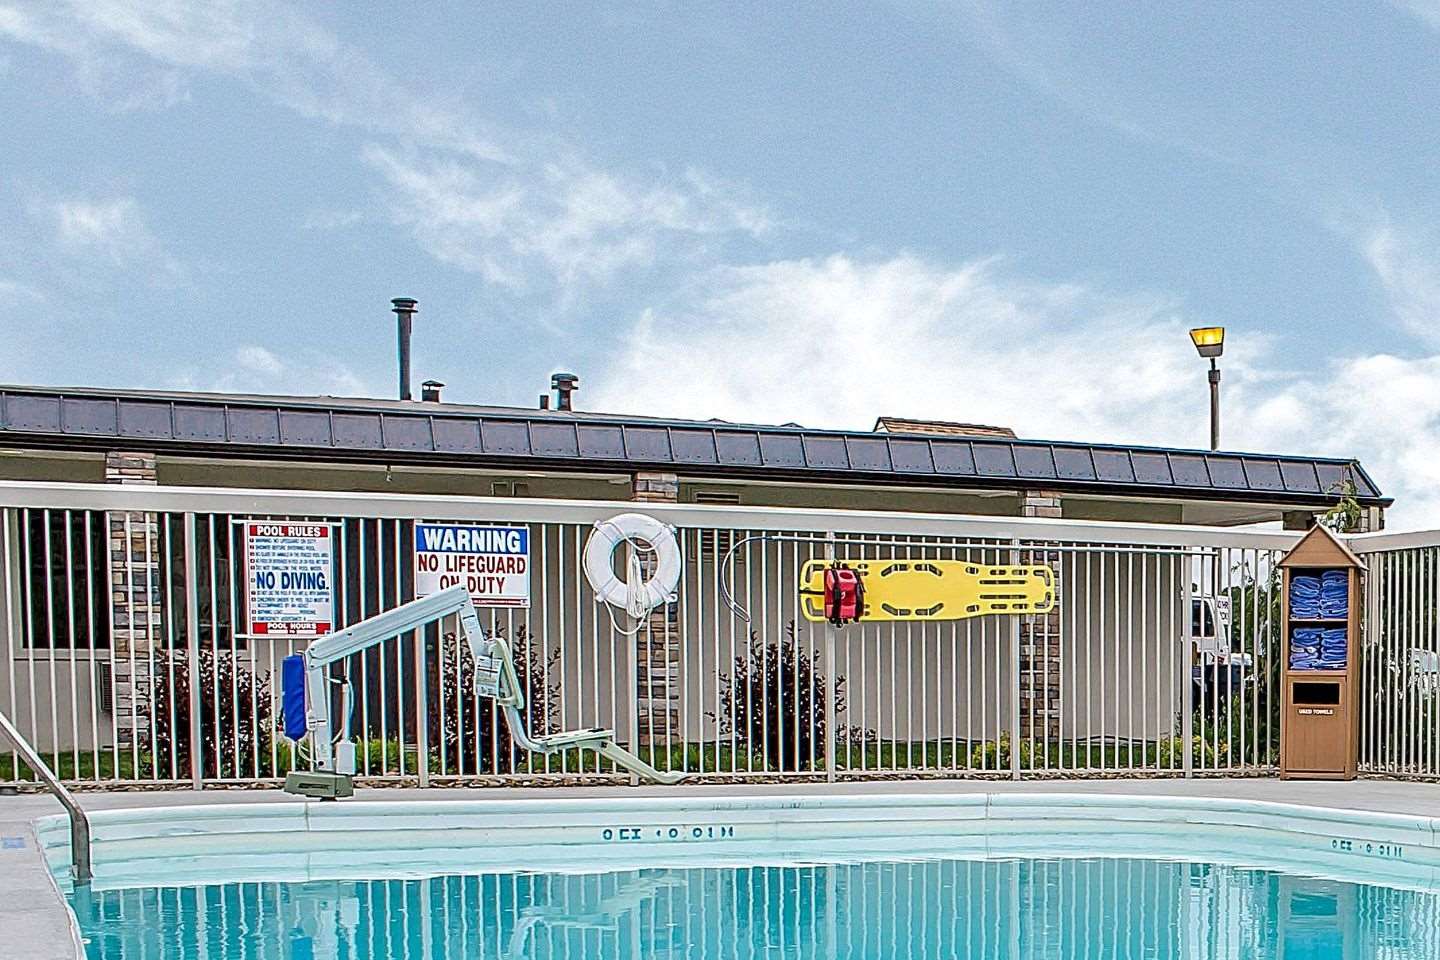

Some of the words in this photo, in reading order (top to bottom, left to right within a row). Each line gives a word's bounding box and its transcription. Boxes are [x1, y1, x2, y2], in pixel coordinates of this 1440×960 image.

[256, 526, 285, 536] POOL
[288, 526, 321, 537] RULES
[423, 528, 521, 553] WARNING
[418, 554, 439, 572] NO
[446, 554, 526, 574] LIFEGUARD
[256, 571, 275, 589] NO
[281, 571, 330, 590] DIVING.
[467, 576, 506, 594] DUTY
[267, 622, 288, 630] POOL
[290, 622, 317, 630] HOURS
